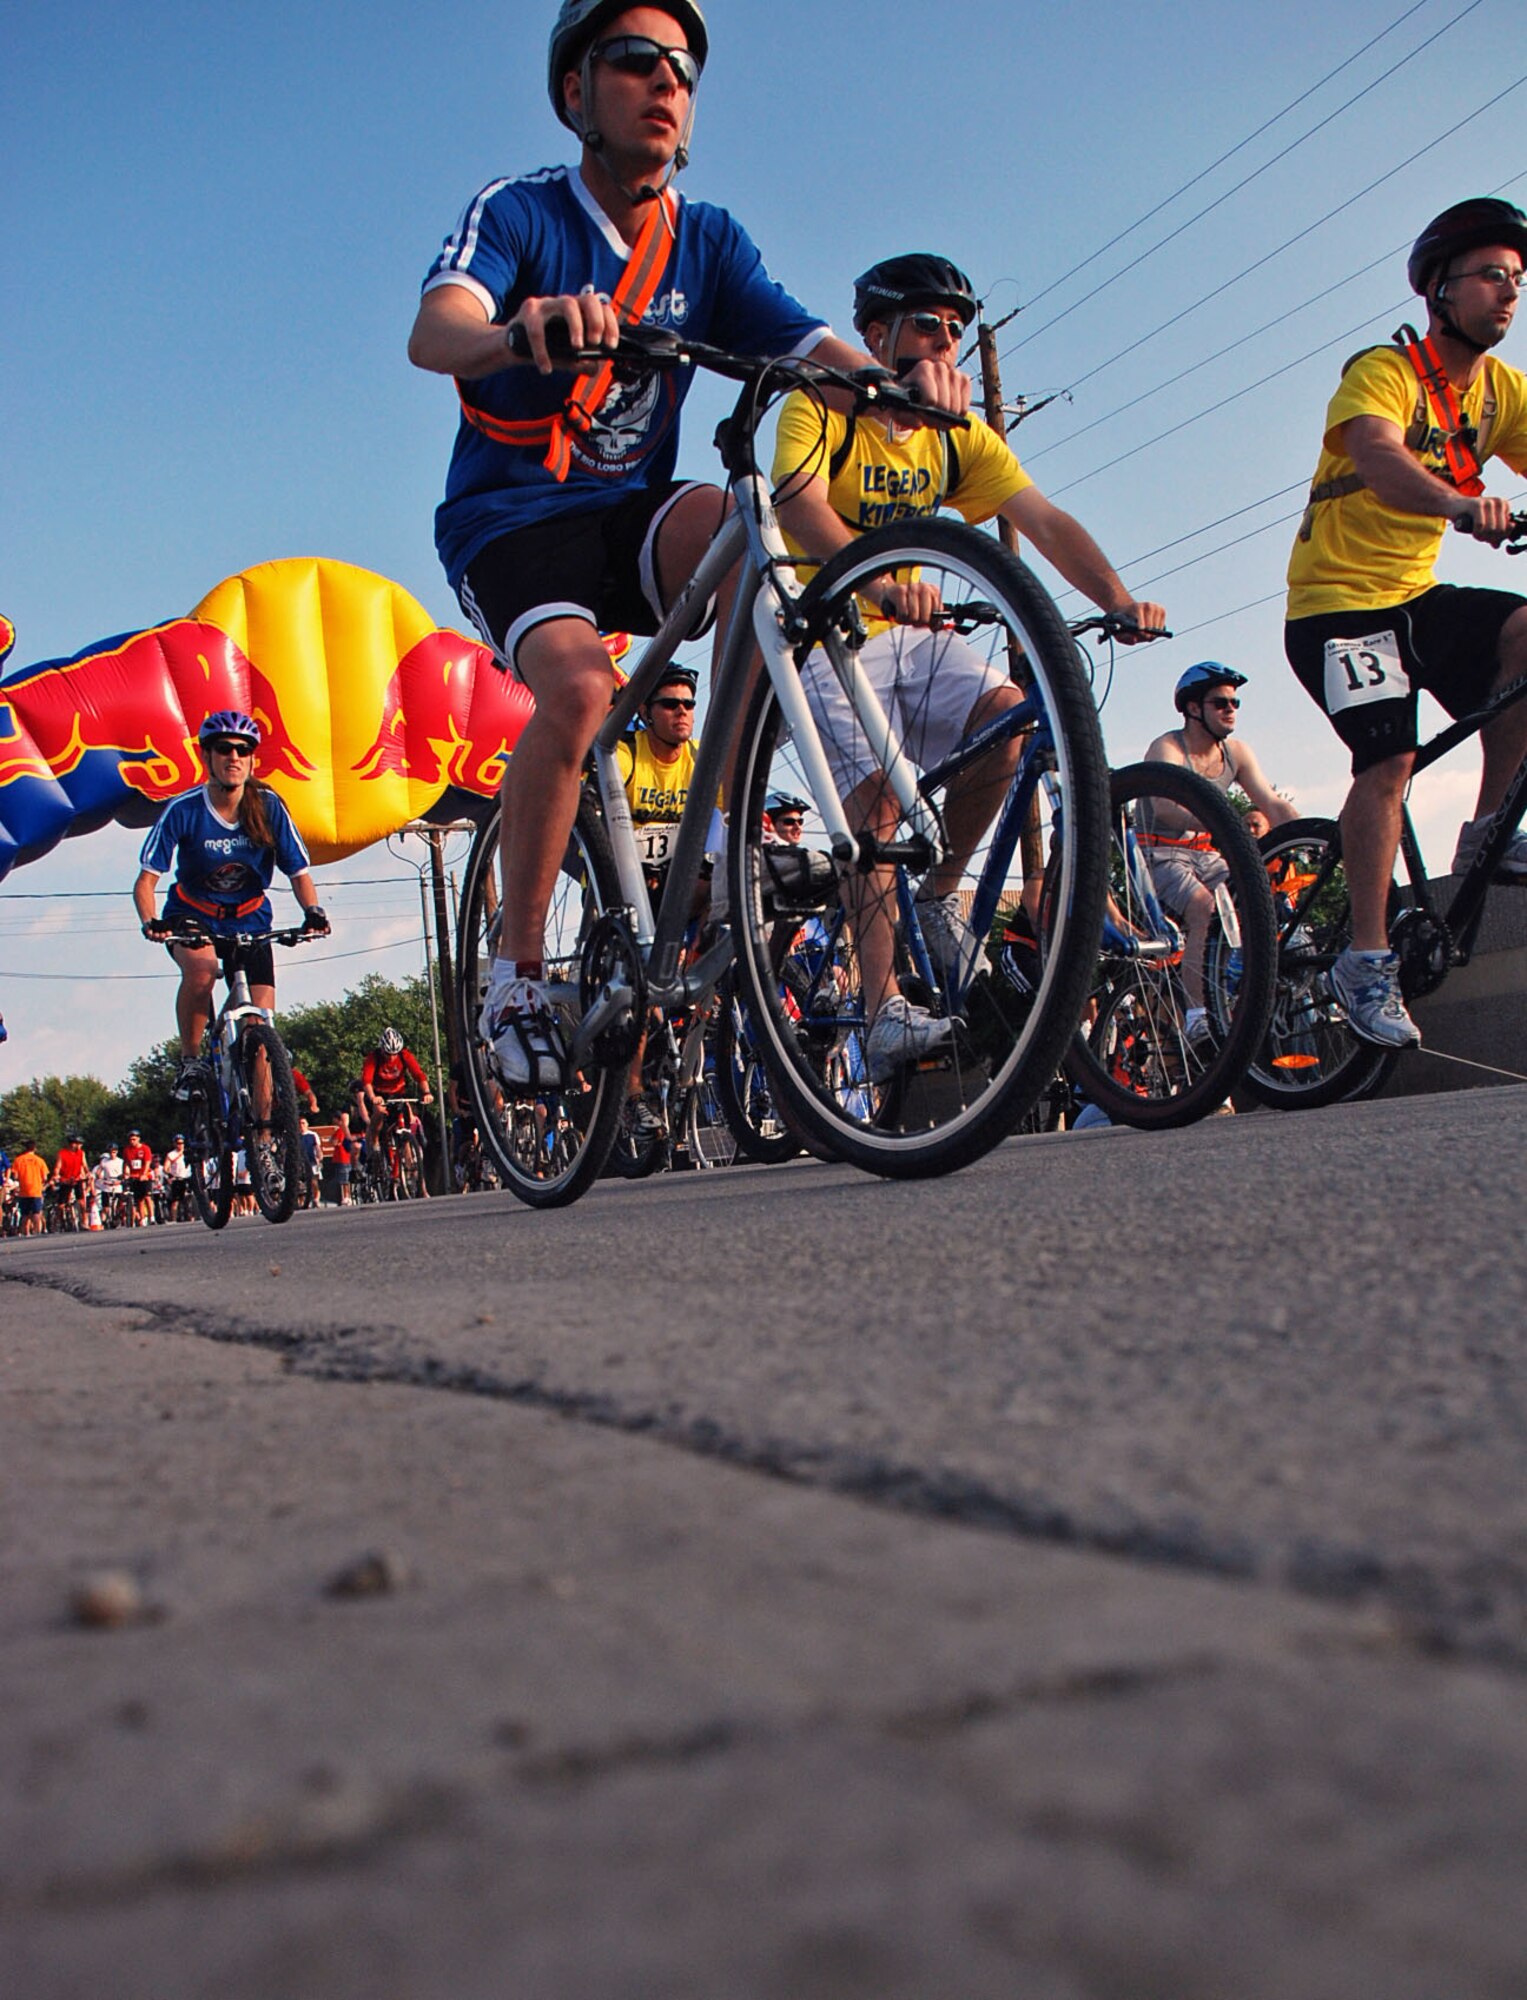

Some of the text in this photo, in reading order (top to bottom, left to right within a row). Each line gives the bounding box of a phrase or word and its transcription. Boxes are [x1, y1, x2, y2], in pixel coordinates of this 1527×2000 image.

[597, 462, 623, 473] LOBO
[1339, 651, 1386, 691] 13
[646, 834, 669, 859] 13
